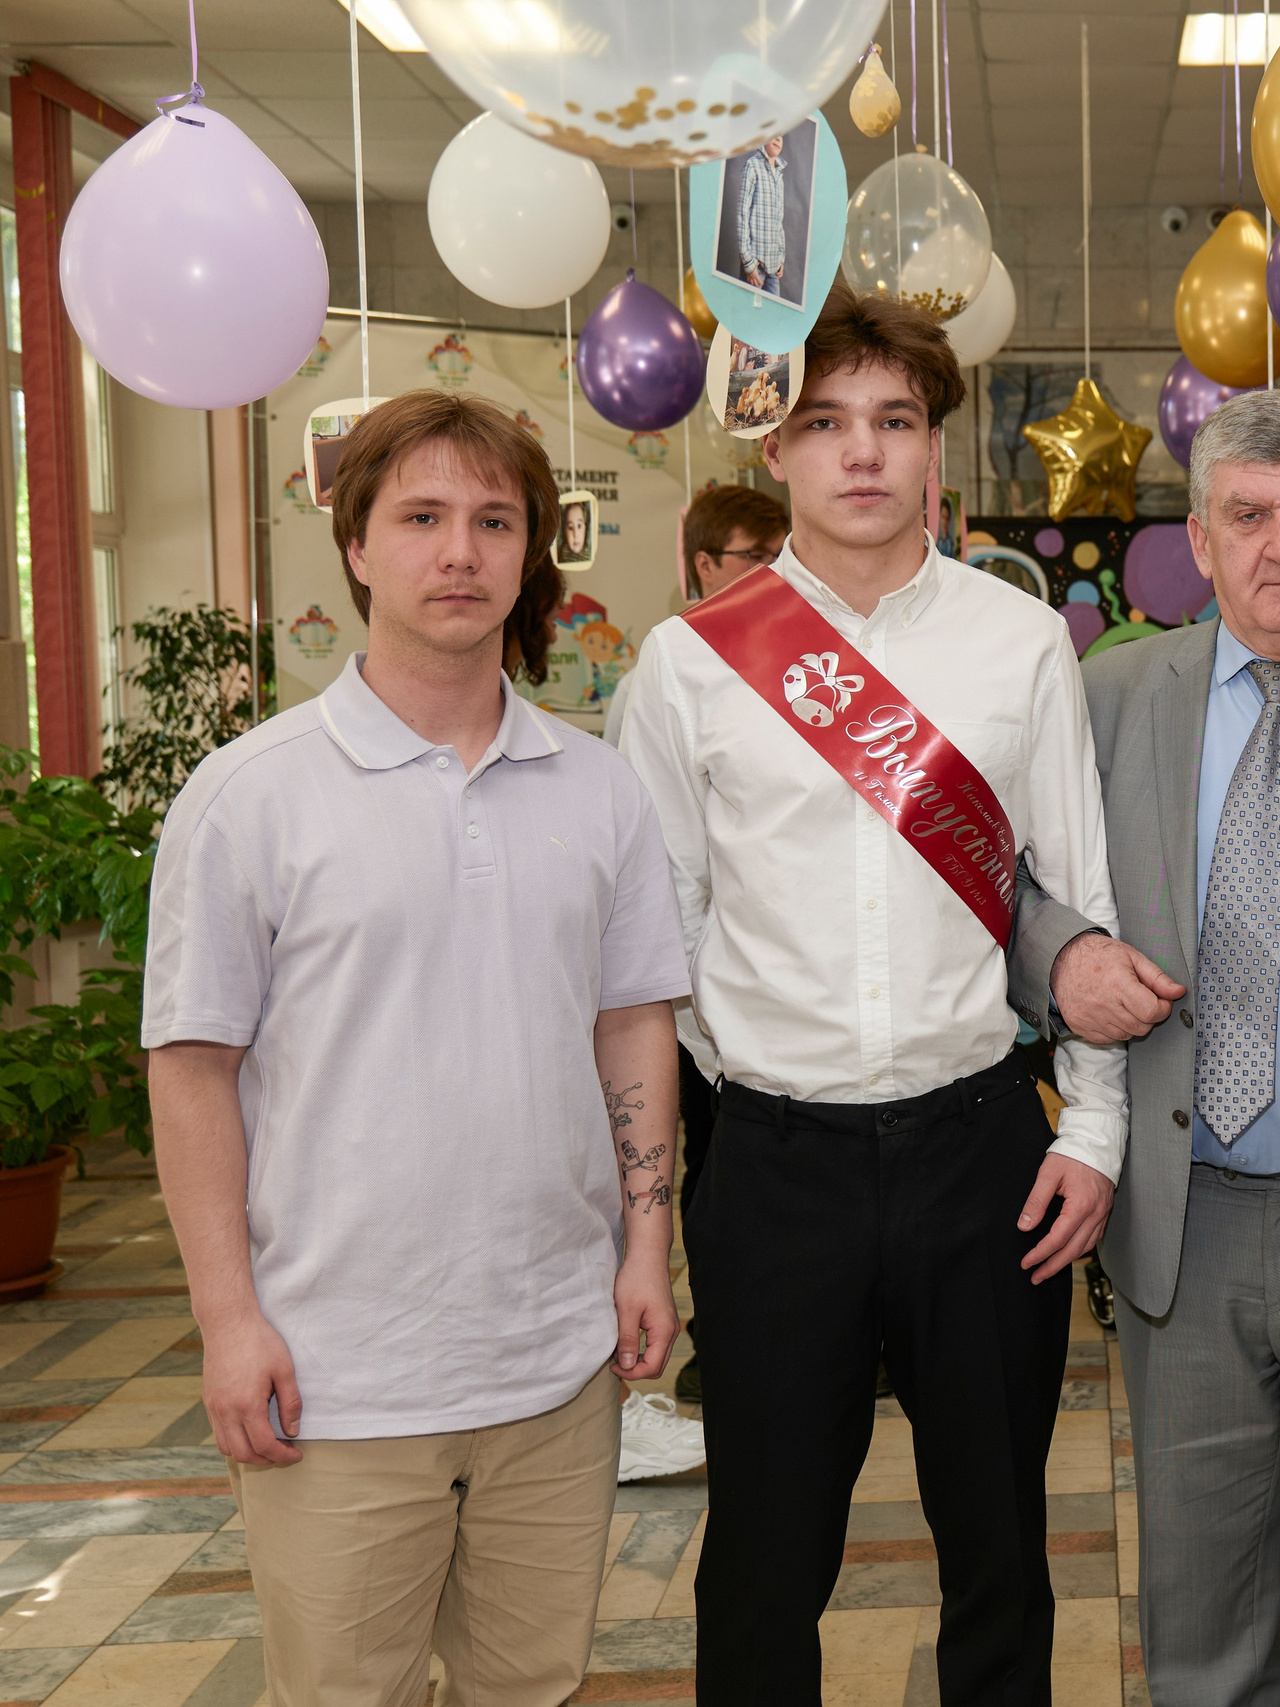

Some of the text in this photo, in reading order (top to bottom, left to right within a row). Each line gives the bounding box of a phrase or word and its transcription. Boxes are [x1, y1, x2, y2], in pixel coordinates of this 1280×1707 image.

[551, 469, 619, 484] ТАМЕНТ
[845, 704, 1015, 913] Выпускник
[874, 791, 902, 816] класс
[956, 779, 1011, 853] Николаев Егор
[940, 853, 976, 888] ГБОУ
